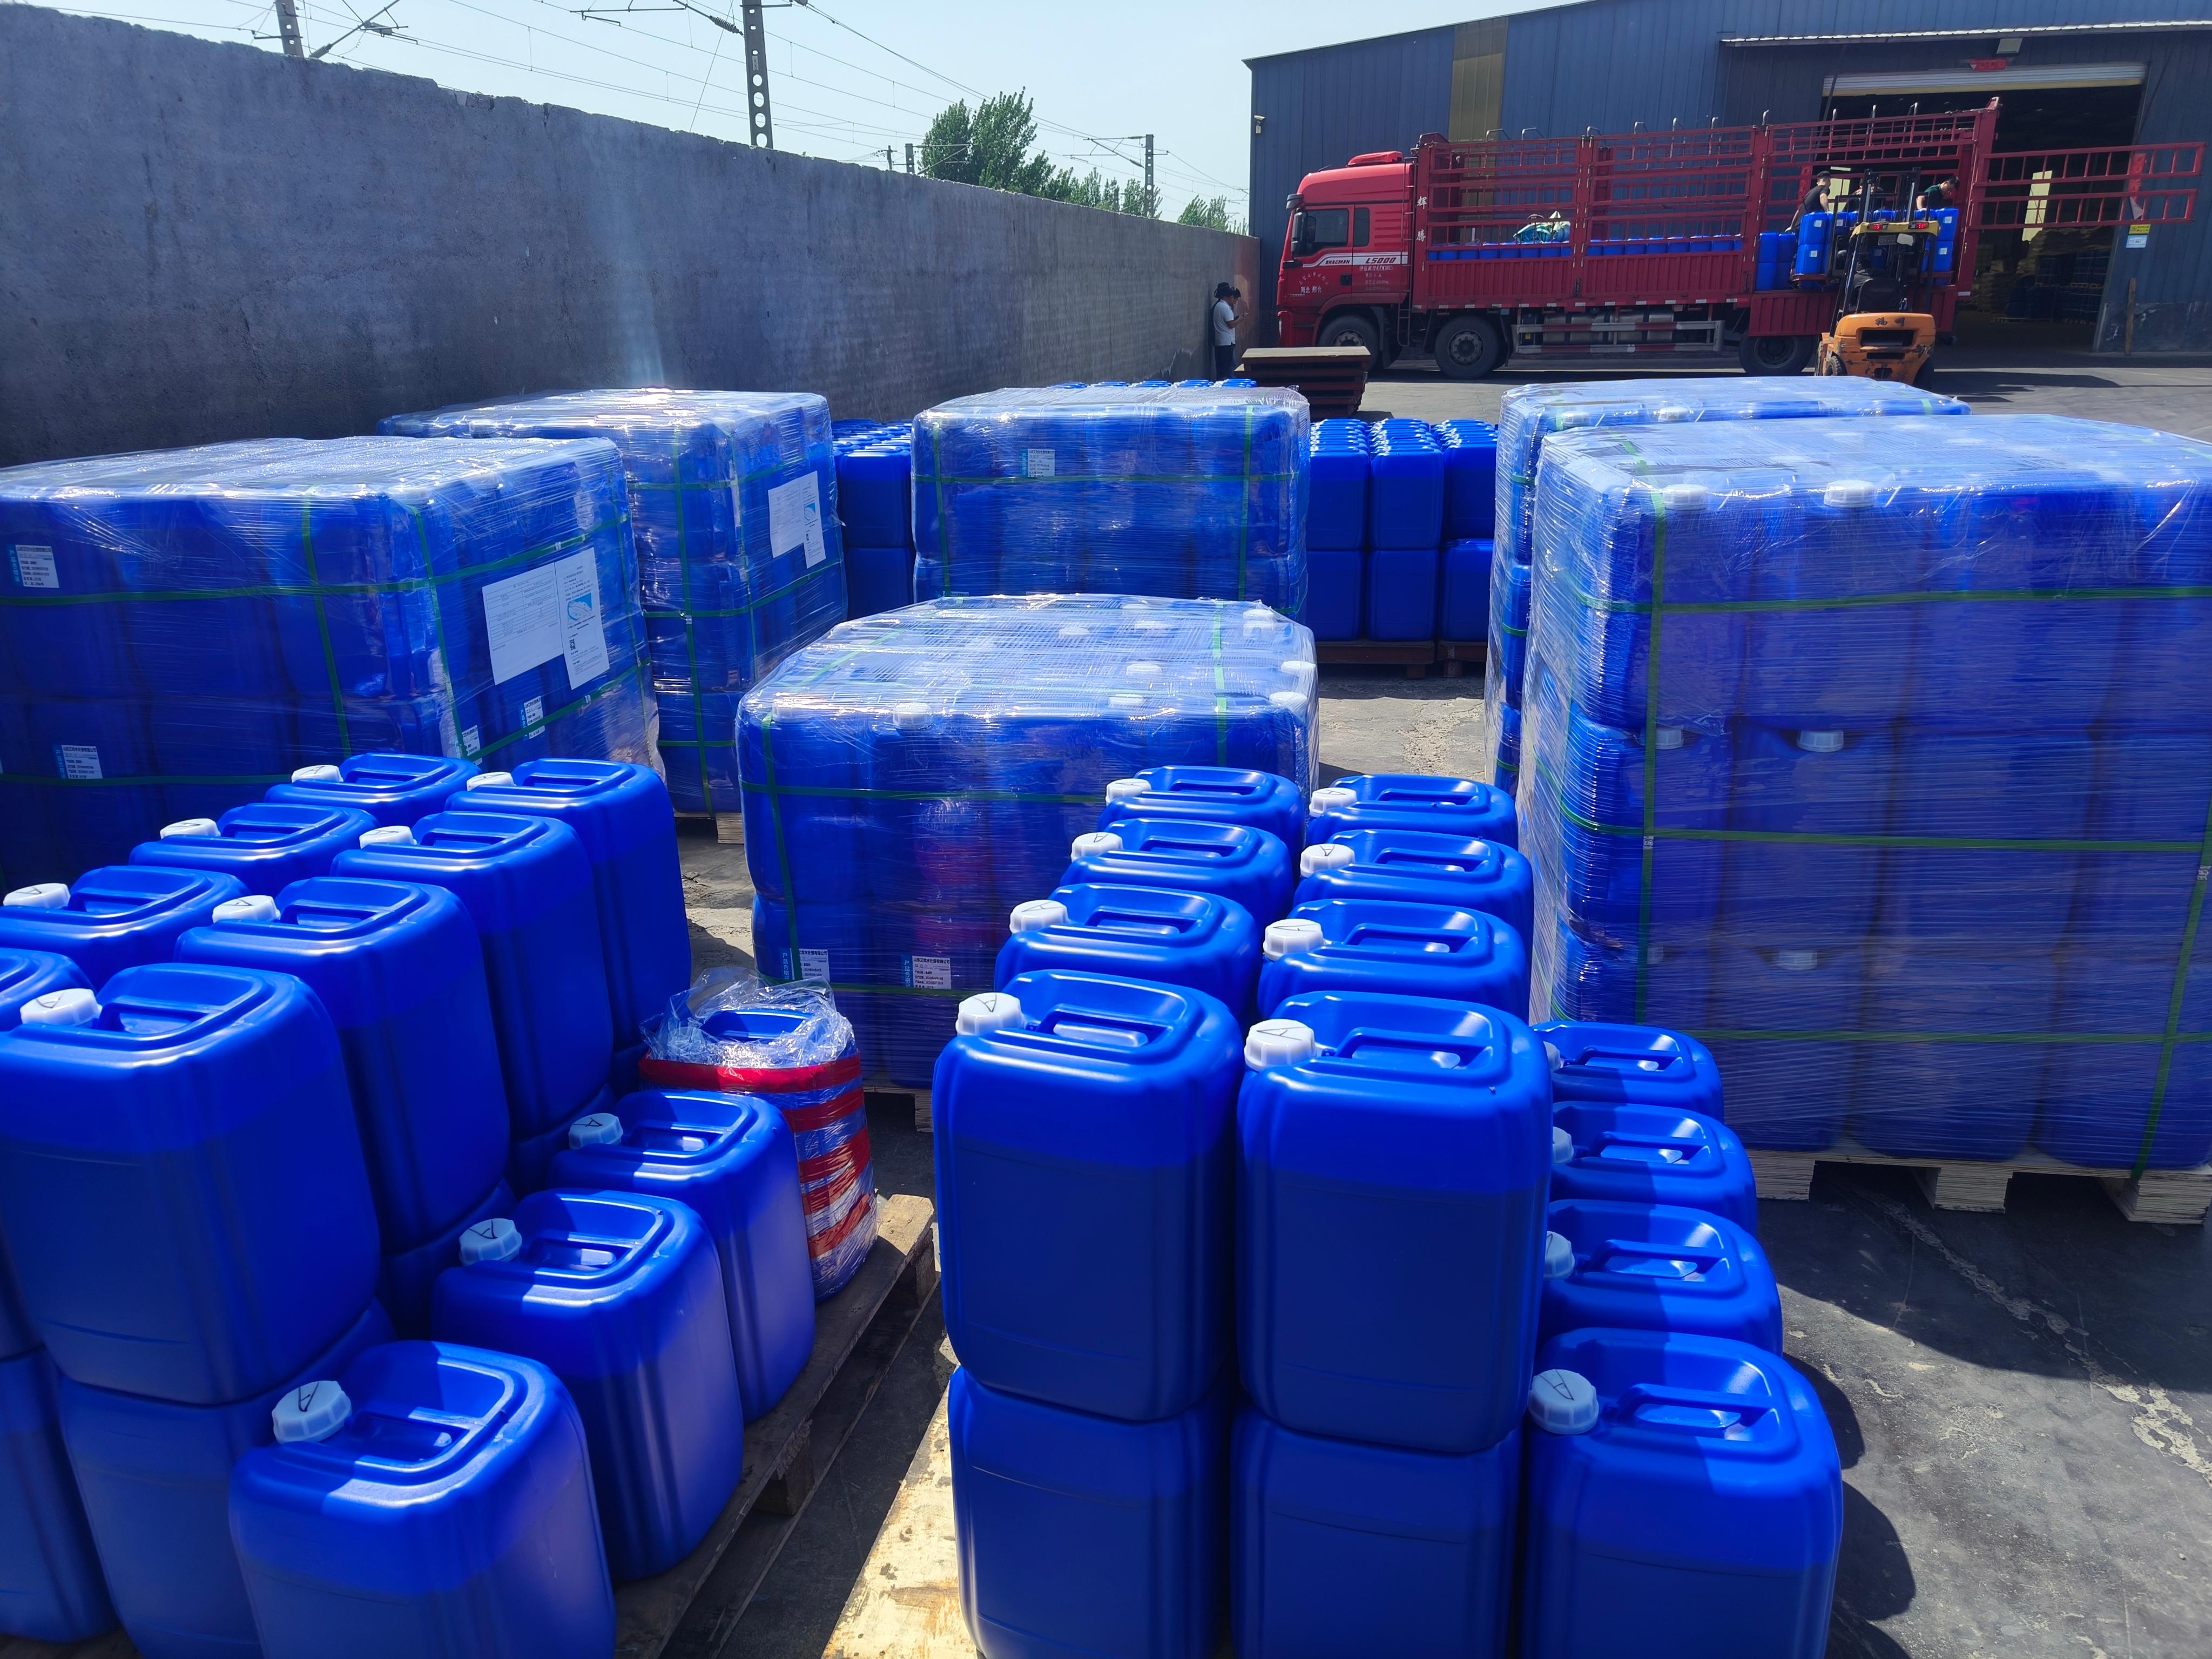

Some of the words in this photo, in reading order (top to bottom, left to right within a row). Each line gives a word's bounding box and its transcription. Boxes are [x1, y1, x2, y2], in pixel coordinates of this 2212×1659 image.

[1094, 833, 1109, 842] A
[1319, 845, 1335, 856] A
[1021, 901, 1063, 912] A
[974, 994, 997, 1012] A
[1256, 1027, 1305, 1041] A
[572, 1117, 603, 1127] A
[469, 1220, 498, 1239] A
[1539, 1369, 1575, 1400] A
[298, 1382, 320, 1412] A
